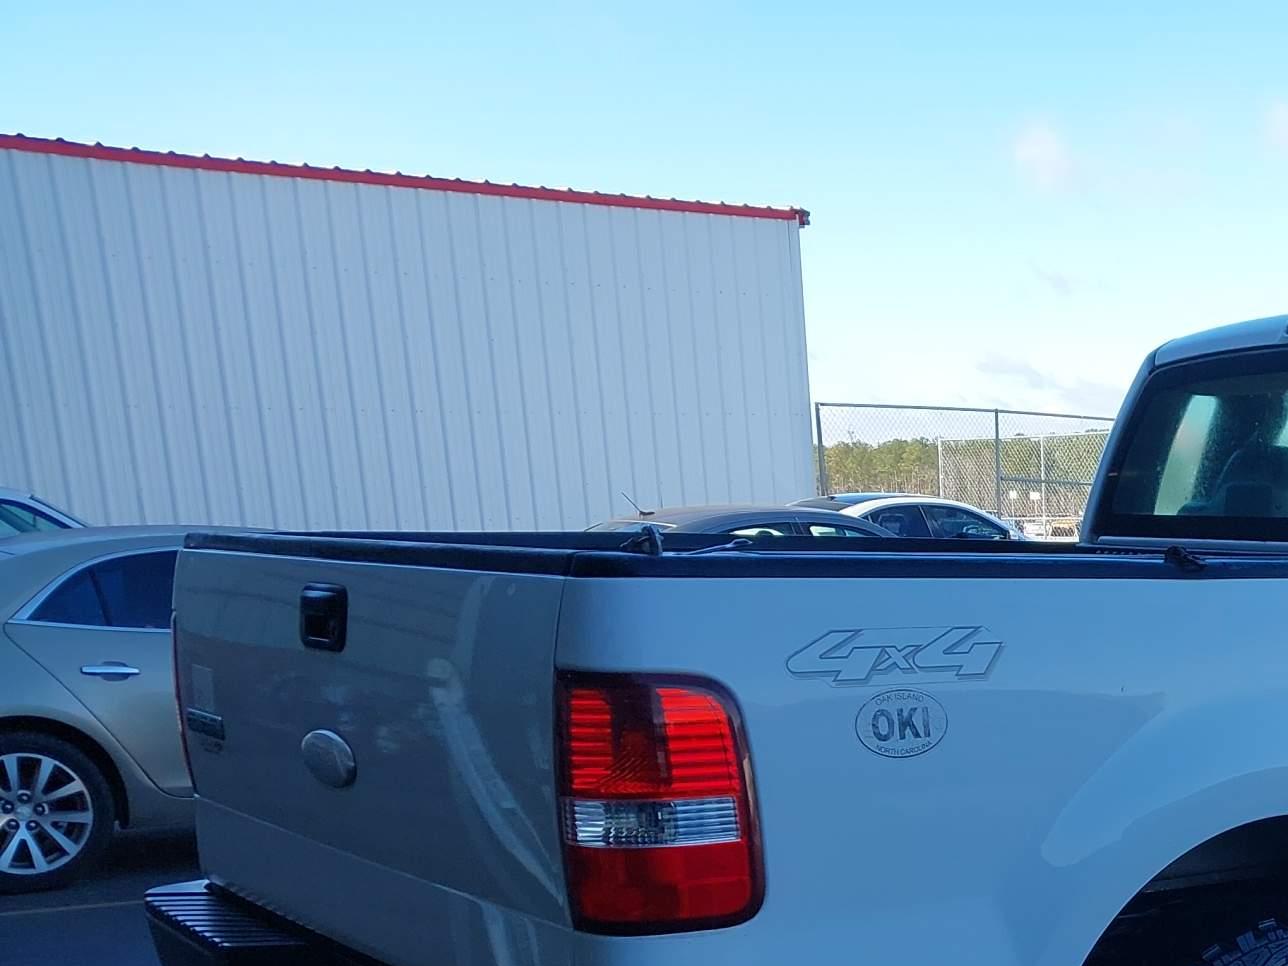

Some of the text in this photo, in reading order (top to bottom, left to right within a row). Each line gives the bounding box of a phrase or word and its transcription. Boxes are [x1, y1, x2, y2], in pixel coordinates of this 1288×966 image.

[785, 625, 1005, 685] 4x4
[875, 692, 925, 706] OAK ISLAND
[871, 706, 931, 742] OKI
[876, 740, 933, 756] NORTH CAROLINA
